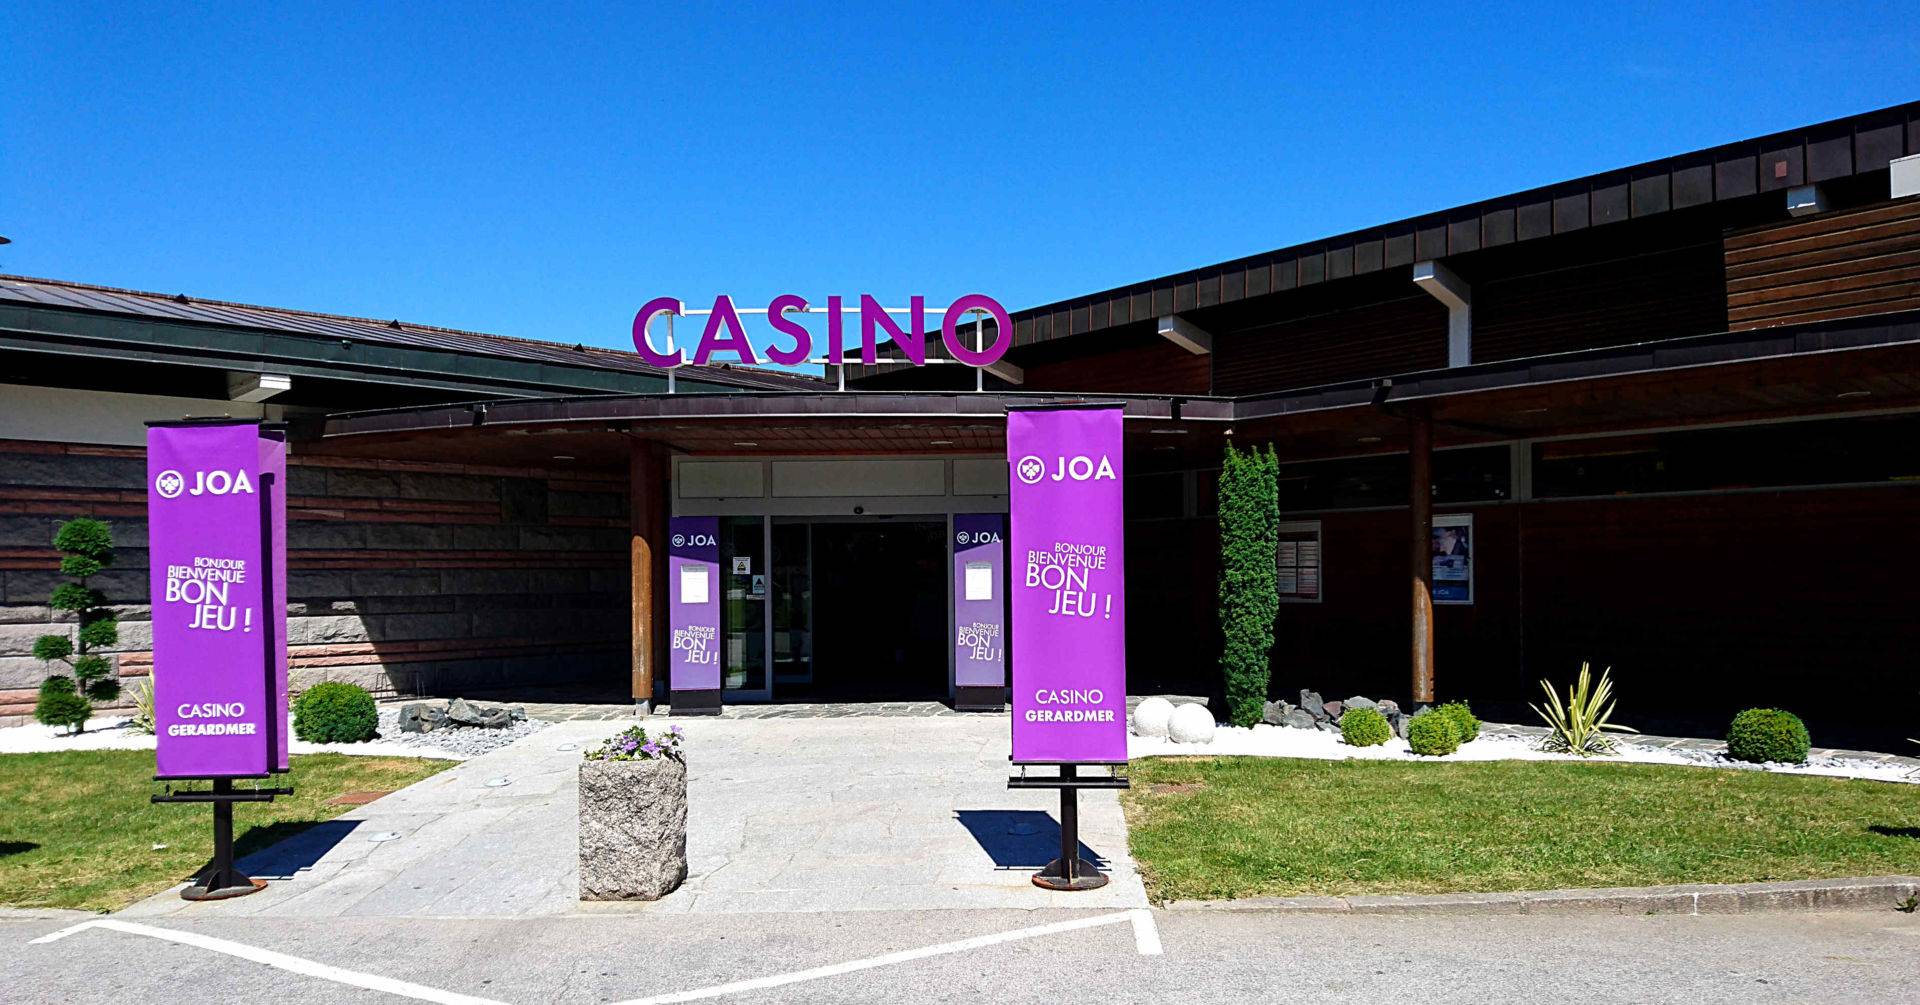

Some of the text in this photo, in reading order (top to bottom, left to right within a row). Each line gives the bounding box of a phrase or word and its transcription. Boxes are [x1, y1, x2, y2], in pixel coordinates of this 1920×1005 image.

[632, 294, 1014, 367] CASINO
[1051, 454, 1116, 481] JOA
[189, 469, 255, 496] JOA
[687, 534, 717, 546] JOA
[972, 532, 1001, 543] JOA
[1055, 542, 1106, 556] BONJOUR
[194, 557, 246, 570] BONJOUR
[1028, 550, 1106, 570] BIENVENUE
[167, 565, 246, 584] BIENVENUE
[1025, 563, 1089, 592] BON
[165, 578, 229, 606] BON
[1048, 589, 1097, 617] JEU
[188, 604, 238, 631] JEU
[688, 625, 715, 633] BONJOUR
[959, 626, 999, 637] BIENVENUE
[973, 622, 999, 630] BONJOUR
[674, 629, 715, 640] BIENVENUE
[958, 632, 990, 648] BON
[673, 636, 706, 651] BON
[684, 649, 710, 664] JEU
[970, 646, 995, 661] JEU
[1035, 689, 1104, 704] CASINO
[177, 702, 245, 718] CASINO
[1025, 709, 1115, 722] GERARDMER
[167, 723, 257, 737] GERARDMER
